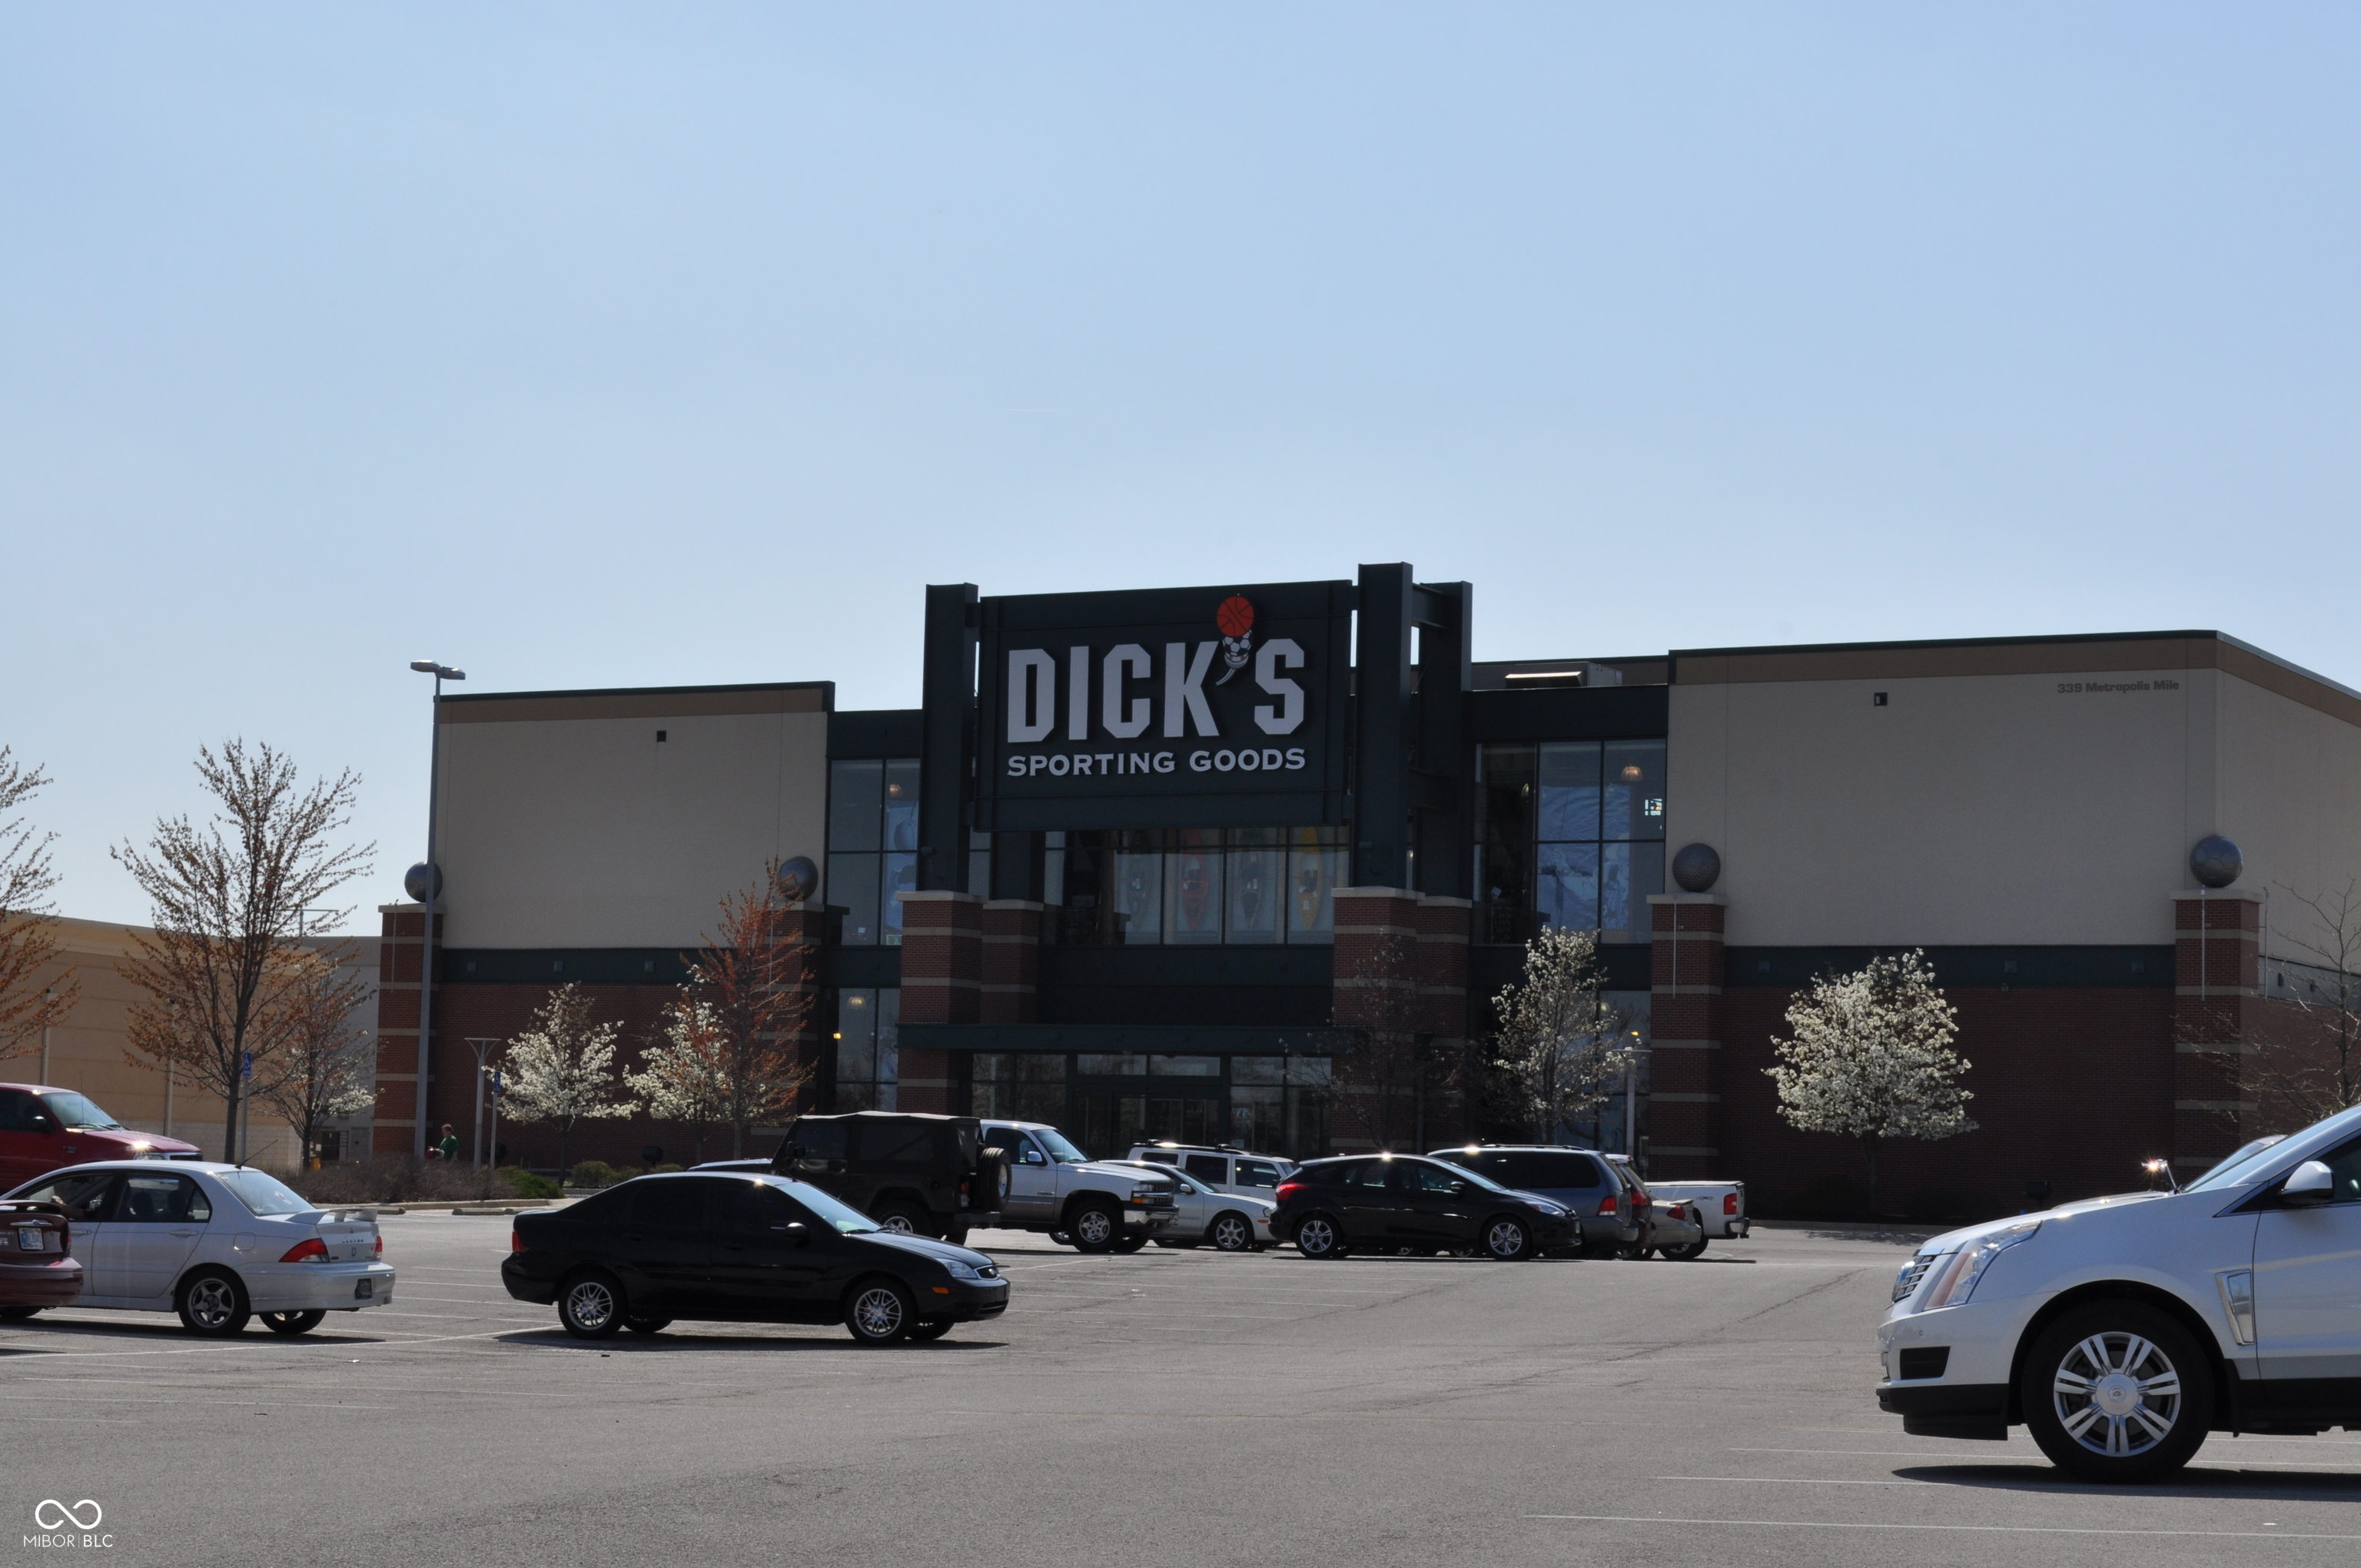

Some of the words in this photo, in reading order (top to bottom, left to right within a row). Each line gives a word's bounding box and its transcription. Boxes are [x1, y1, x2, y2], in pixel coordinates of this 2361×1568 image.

[1007, 638, 1305, 743] DICK'S
[2057, 683, 2082, 693] 339
[2085, 681, 2150, 693] Metropolis
[2153, 680, 2180, 690] Mile
[1007, 751, 1176, 777] SPORTING
[1189, 748, 1307, 772] GOODS
